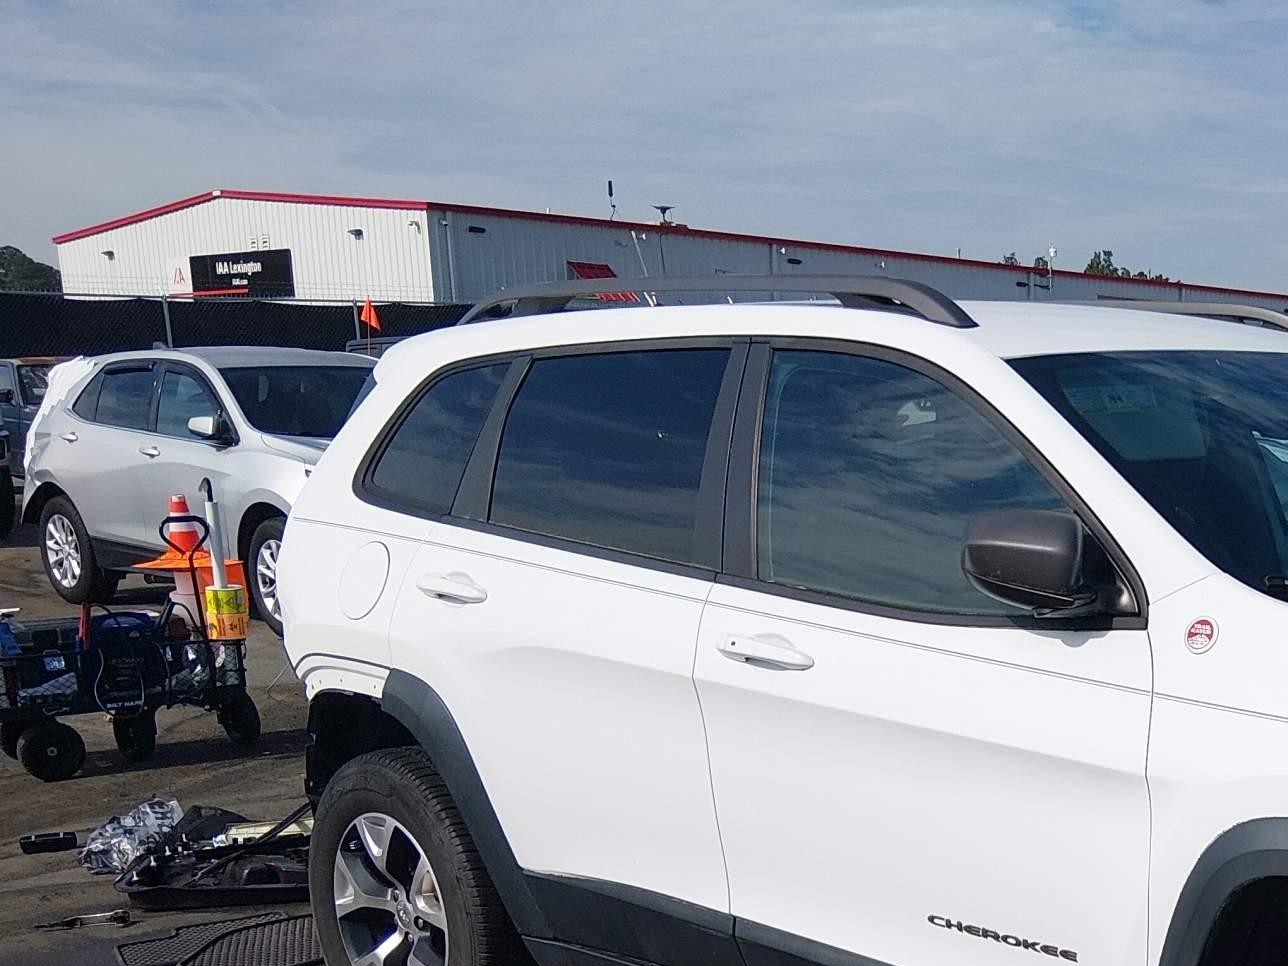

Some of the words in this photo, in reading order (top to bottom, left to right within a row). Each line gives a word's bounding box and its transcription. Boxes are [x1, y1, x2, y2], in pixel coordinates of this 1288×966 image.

[216, 261, 229, 275] IAA
[230, 260, 262, 276] Lexington
[927, 914, 1078, 963] CHEROKEE
